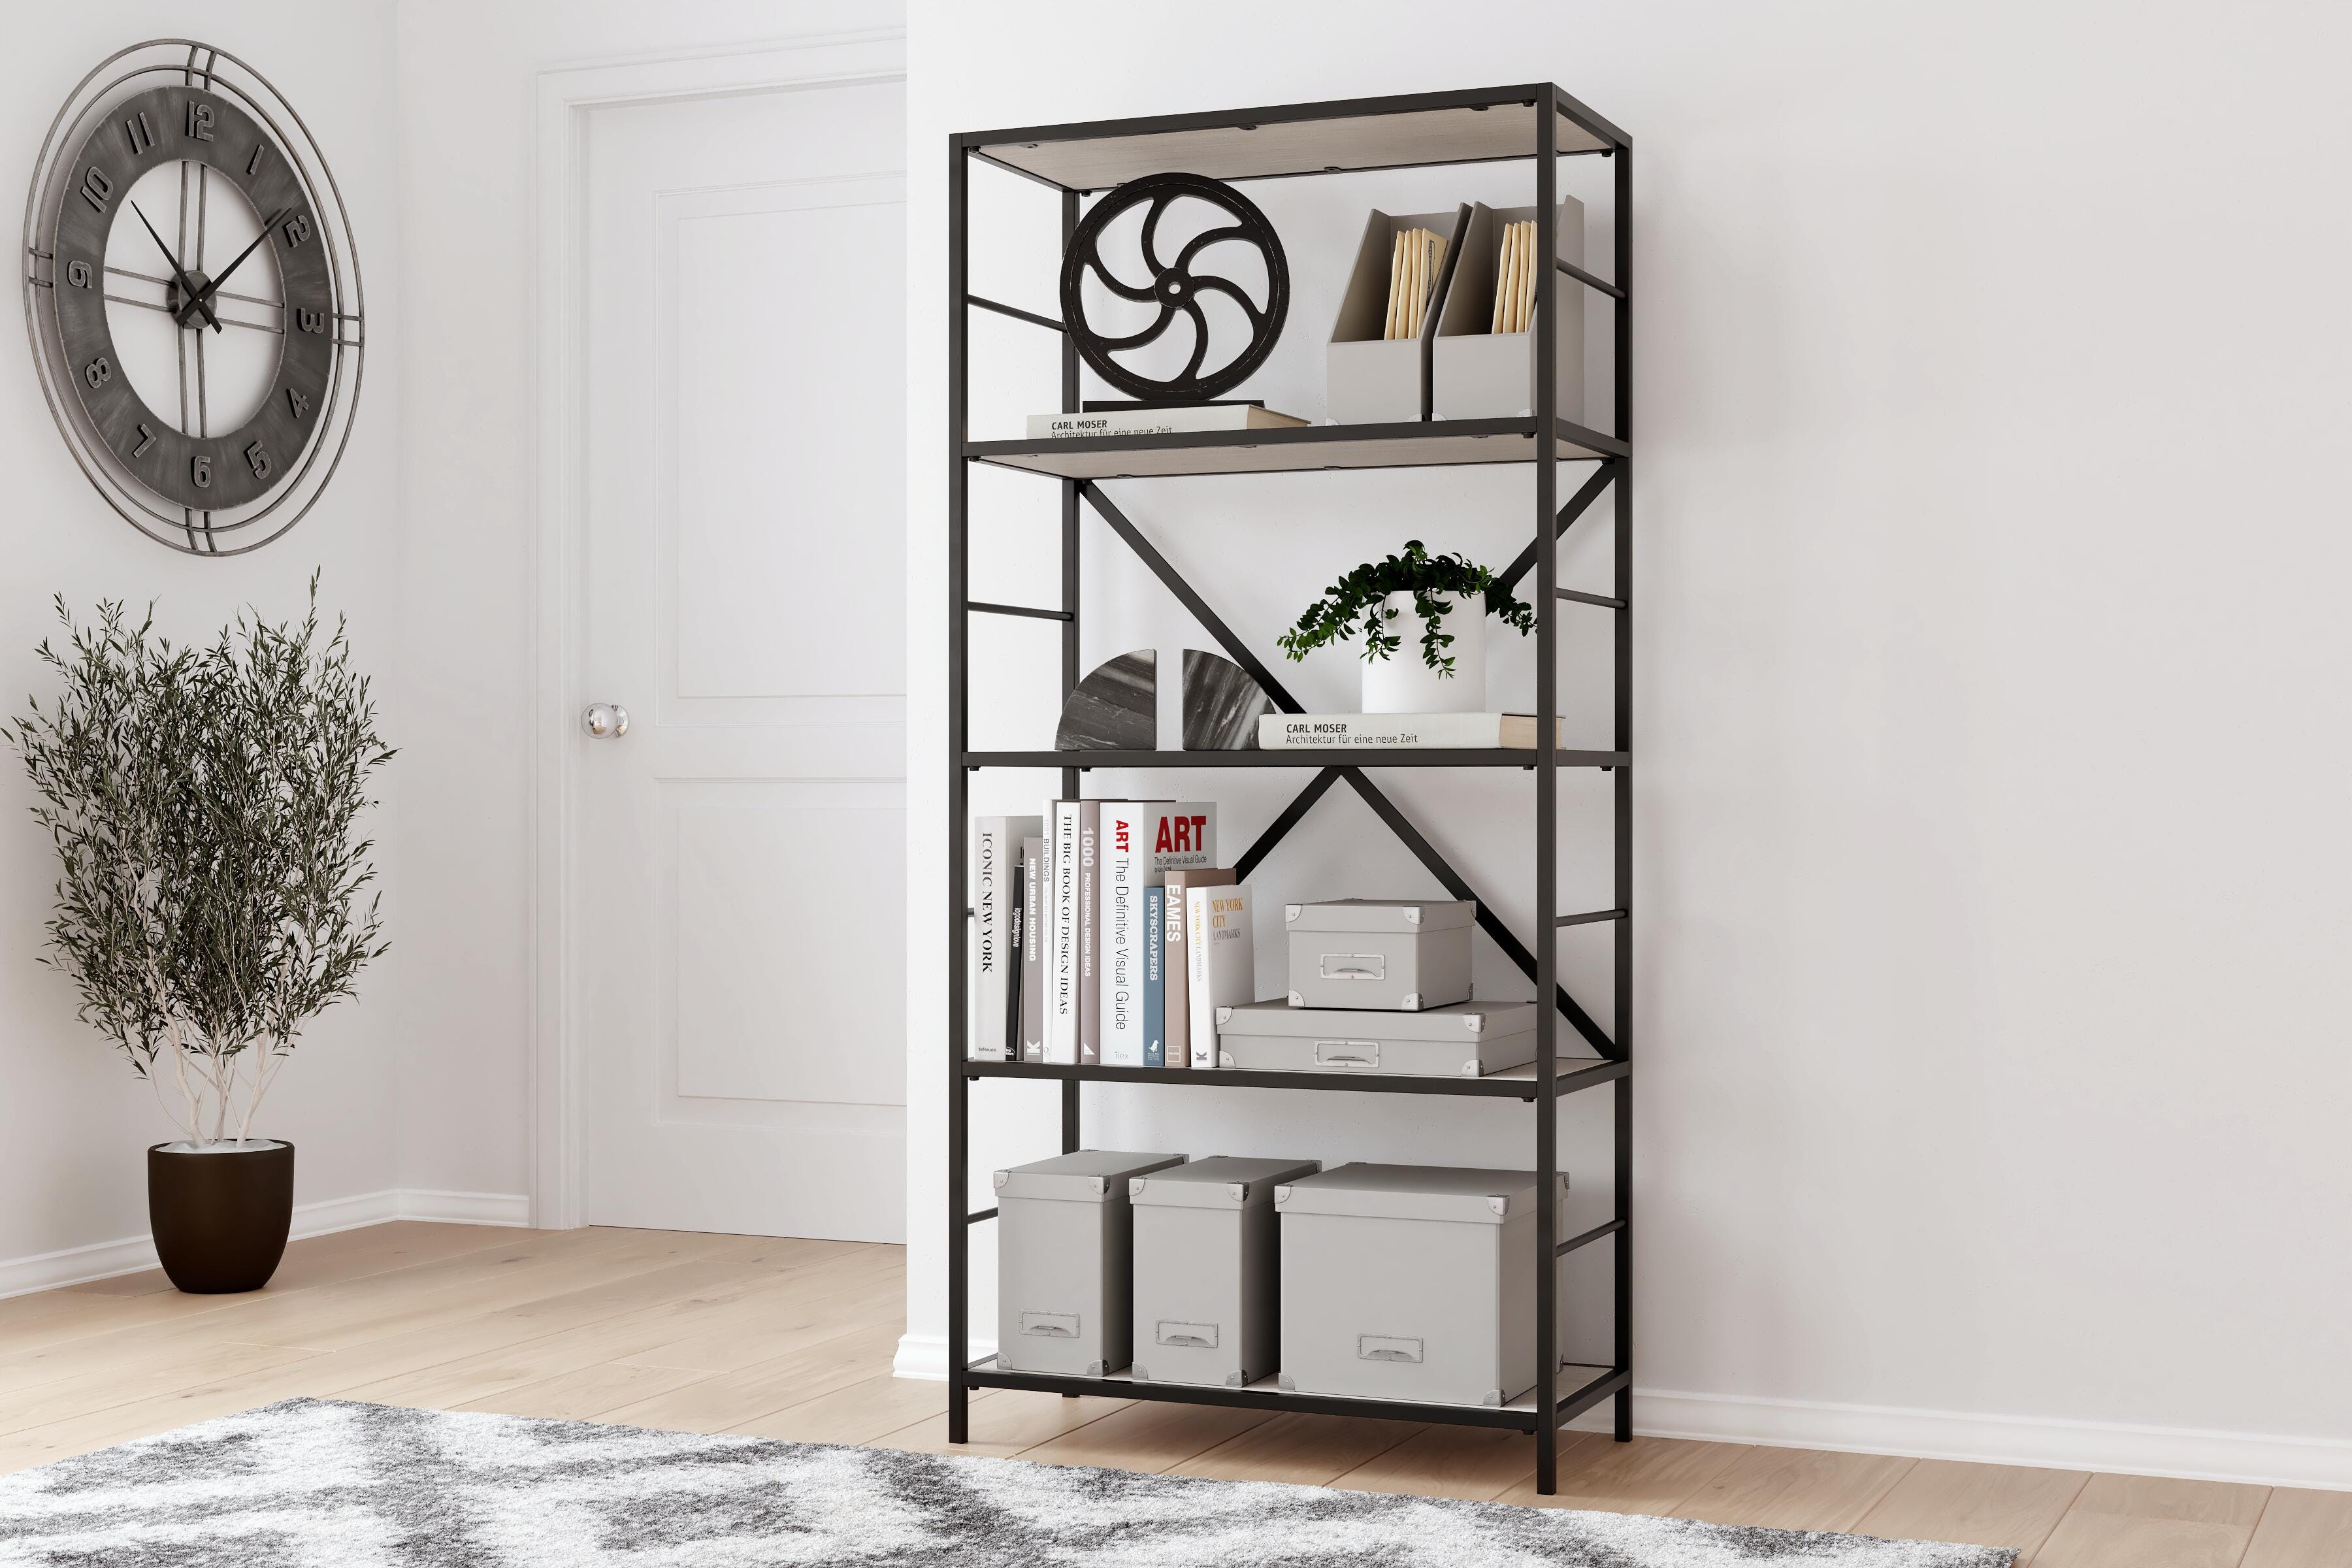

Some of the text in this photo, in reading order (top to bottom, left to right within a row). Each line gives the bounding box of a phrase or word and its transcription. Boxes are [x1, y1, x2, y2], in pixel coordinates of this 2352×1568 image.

[126, 112, 155, 155] 11
[187, 101, 215, 142] 12
[249, 144, 265, 175] 1
[81, 166, 114, 213] 10
[286, 214, 311, 248] 2
[68, 260, 93, 289] 9
[299, 308, 325, 334] 3
[86, 357, 112, 389] 8
[289, 387, 309, 419] 4
[133, 423, 157, 458] 7
[1051, 420, 1107, 430] CARL MOSER
[1051, 430, 1097, 439] Architektur
[193, 455, 211, 488] 6
[248, 440, 272, 480] 5
[1286, 724, 1347, 733] CARL MOSER
[1286, 734, 1335, 743] Architektur
[1339, 734, 1351, 743] für
[1354, 734, 1373, 743] eine
[1400, 734, 1418, 743] Zeit
[1083, 827, 1094, 867] 1000
[1155, 815, 1206, 853] ART
[1163, 856, 1182, 865] Definitive
[1182, 855, 1194, 864] Visual
[1194, 855, 1207, 863] Guide
[983, 833, 992, 972] ICONIC NEW YORK
[1060, 815, 1072, 1015] THE BIG BOOK OF DESIGN IDEAS
[1166, 885, 1181, 942] EAMES
[1213, 898, 1243, 913] NEW YORK
[1012, 907, 1022, 947] logodesignlove
[1115, 820, 1129, 1030] ART The Definitive Visual Guide
[1149, 895, 1158, 981] SKYSCRAPERS
[1213, 915, 1226, 928] CITY
[1213, 928, 1241, 941] LANDMARKS
